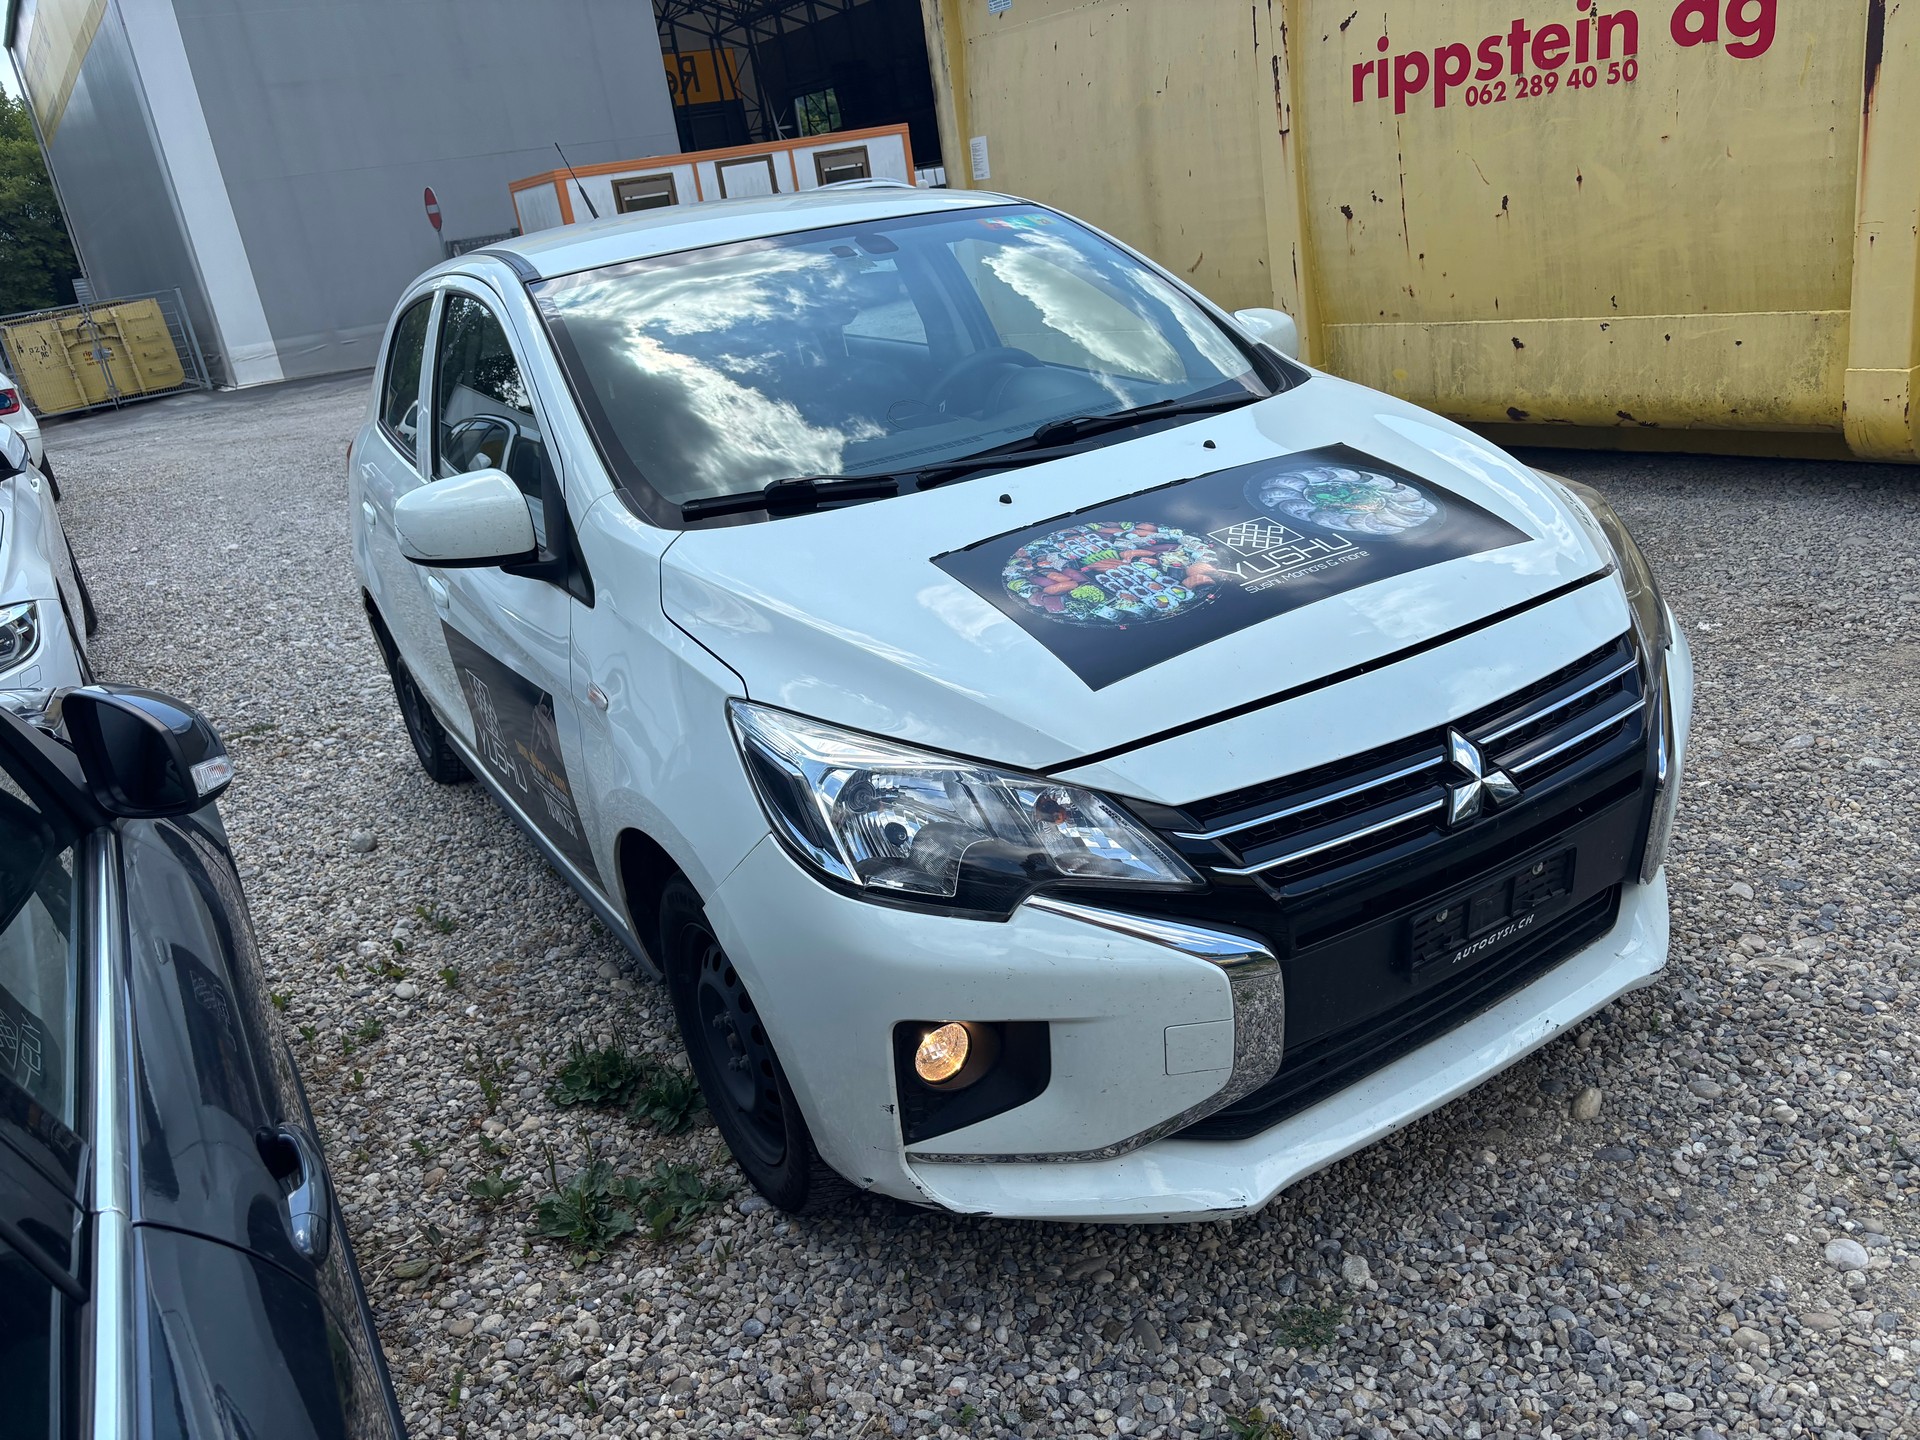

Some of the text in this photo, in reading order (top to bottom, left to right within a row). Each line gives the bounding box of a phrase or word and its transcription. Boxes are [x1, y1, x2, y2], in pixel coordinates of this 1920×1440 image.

[1352, 0, 1778, 115] rippstein ag
[1465, 58, 1639, 107] 062 289 40 50
[1218, 532, 1353, 580] YUSHU
[1245, 550, 1371, 594] Sushi, Momo's & more
[476, 723, 529, 793] YUSHU
[1452, 913, 1535, 964] AUTOGYSI.CH
